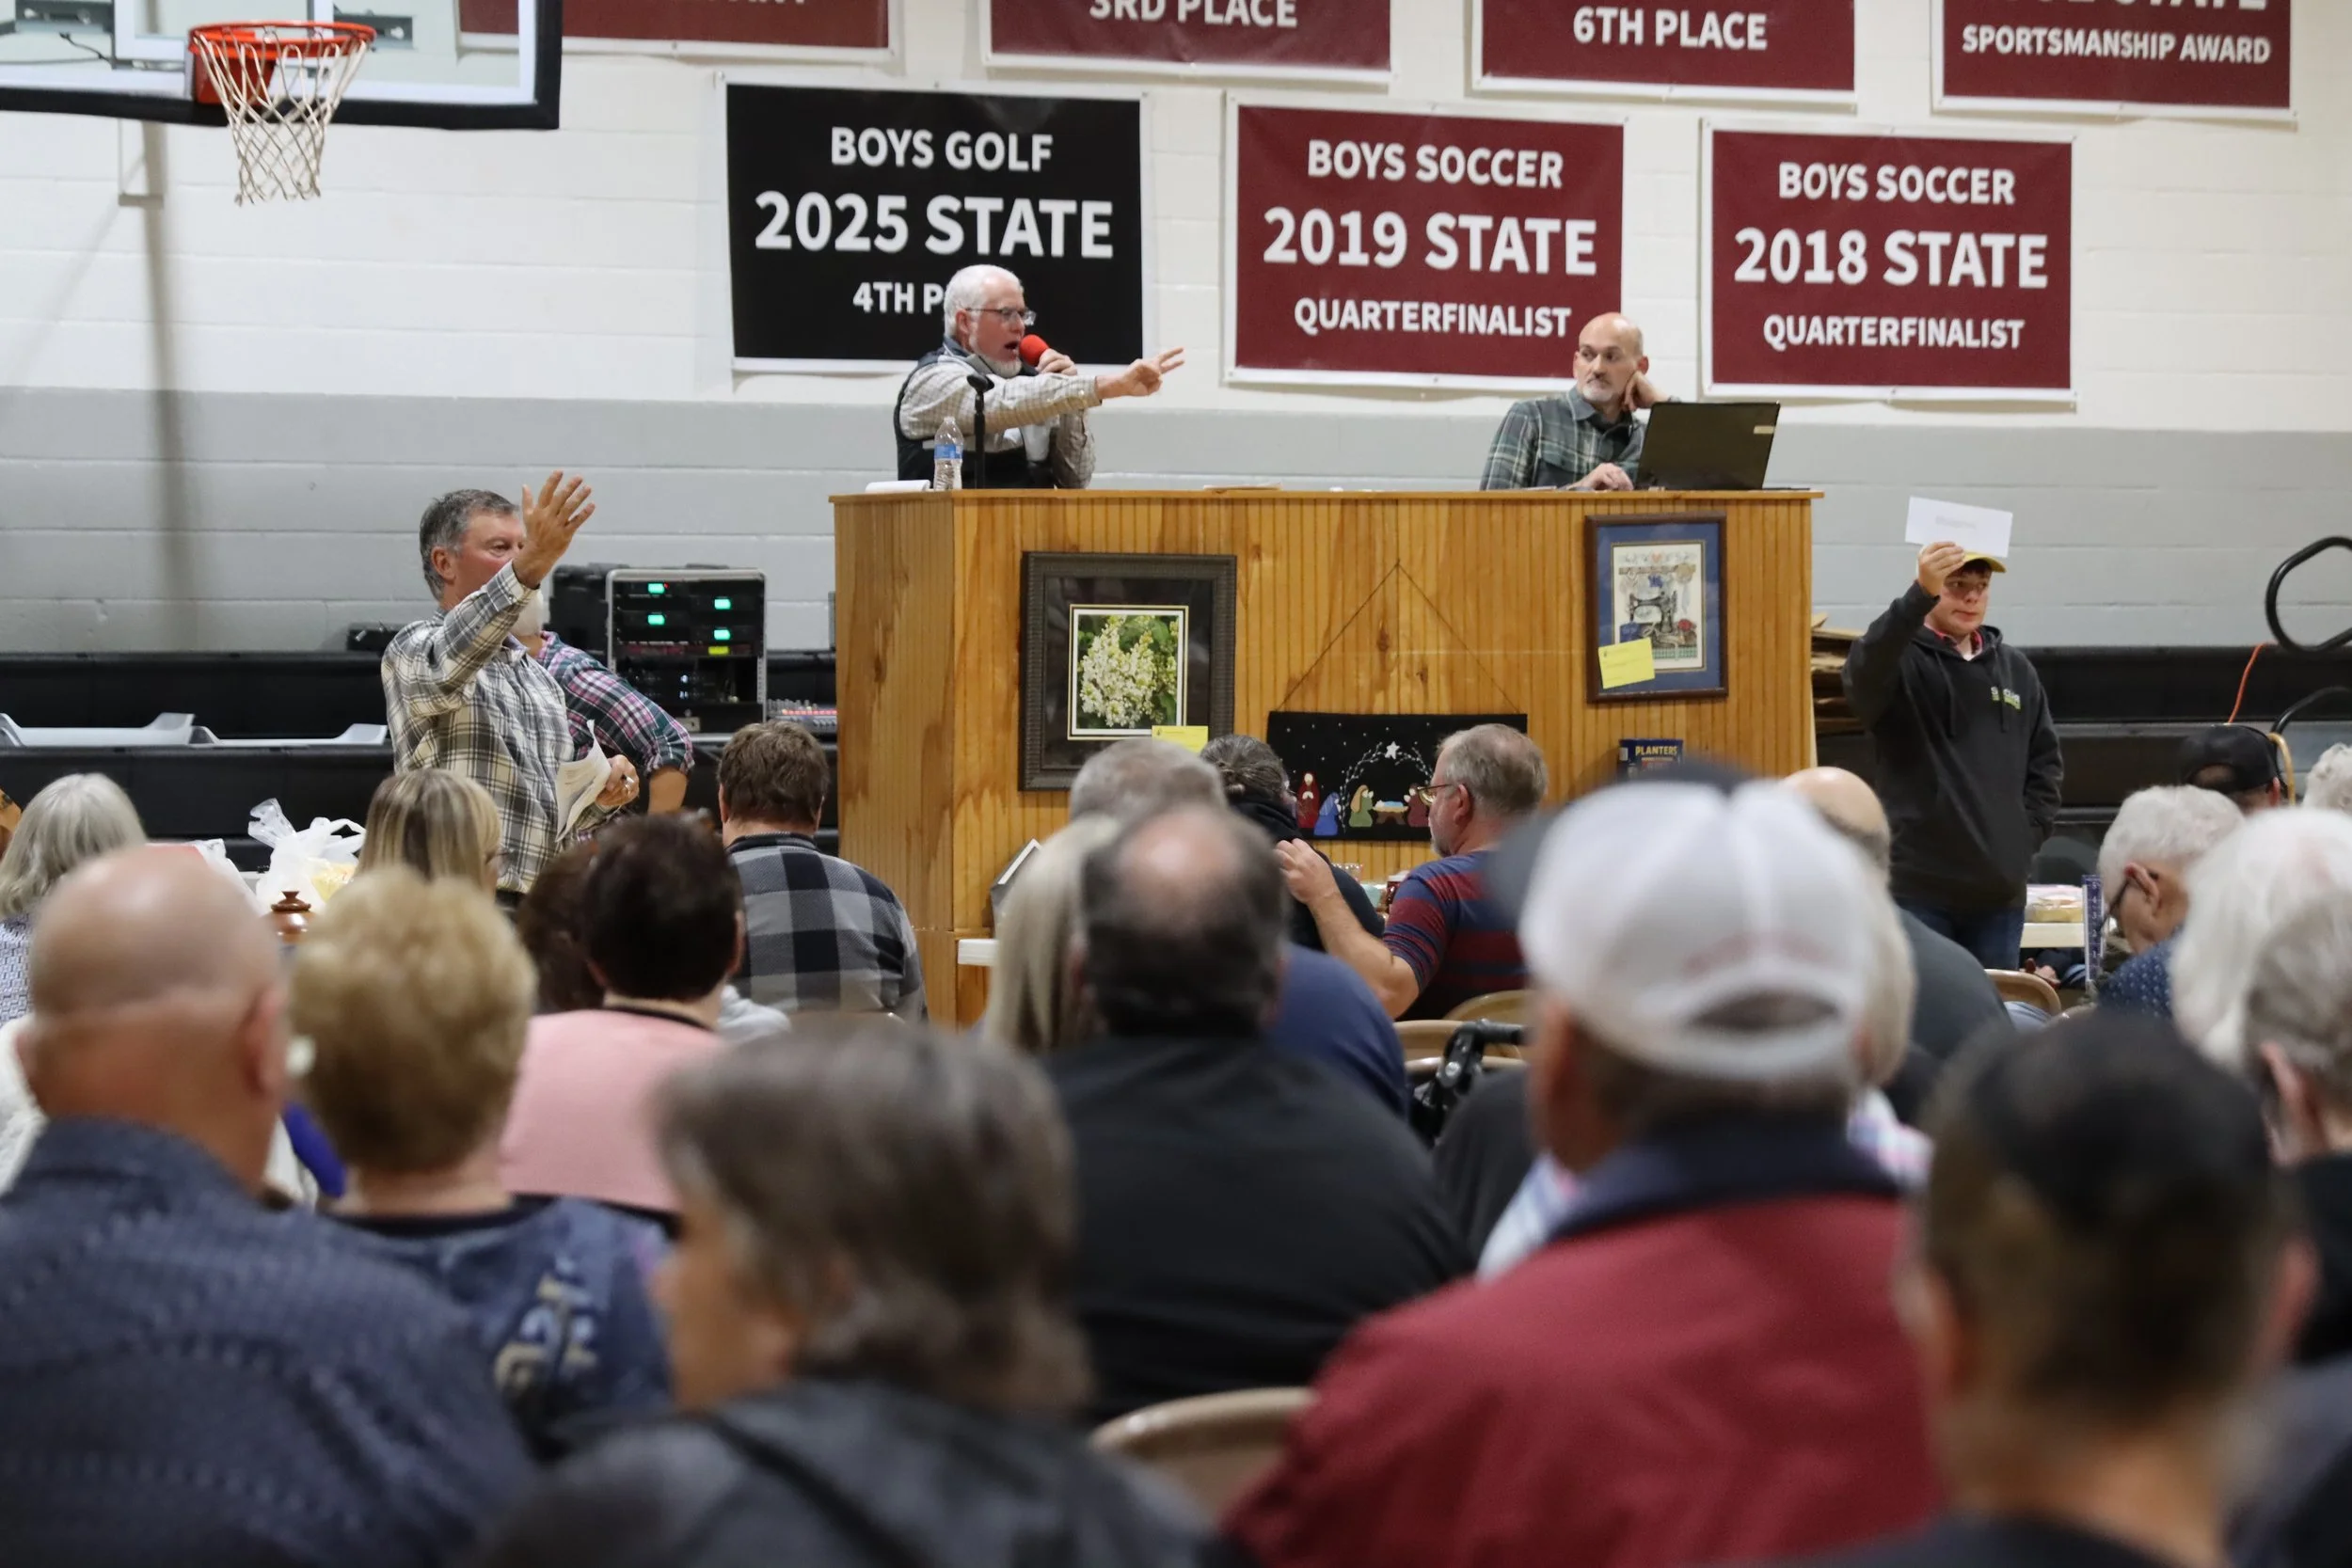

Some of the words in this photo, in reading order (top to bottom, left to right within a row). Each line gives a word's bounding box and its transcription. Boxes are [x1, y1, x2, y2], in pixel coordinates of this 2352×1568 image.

[1089, 0, 1166, 21] 3RD
[1177, 0, 1297, 27] PLACE
[1573, 7, 1644, 45] 6TH
[1655, 9, 1768, 51] PLACE
[1962, 24, 2176, 60] SPORTSMANSHIP
[2179, 34, 2270, 63] AWARD
[831, 127, 934, 167] BOYS
[945, 131, 1053, 171] GOLF
[1308, 139, 1406, 181] BOYS
[1415, 144, 1564, 189] SOCCER
[1779, 162, 1868, 201] BOYS
[1875, 165, 2015, 205] SOCCER
[755, 191, 909, 252] 2025
[925, 195, 1113, 259] STATE
[1263, 206, 1407, 268] 2019
[1424, 212, 1597, 276] STATE
[1734, 227, 1868, 285] 2018
[1883, 230, 2048, 289] STATE
[852, 281, 914, 313] 4TH
[1293, 296, 1572, 338] QUARTERFINALIST
[1763, 314, 2026, 352] QUARTERFINALIST
[1634, 744, 1678, 757] PLANTERS
